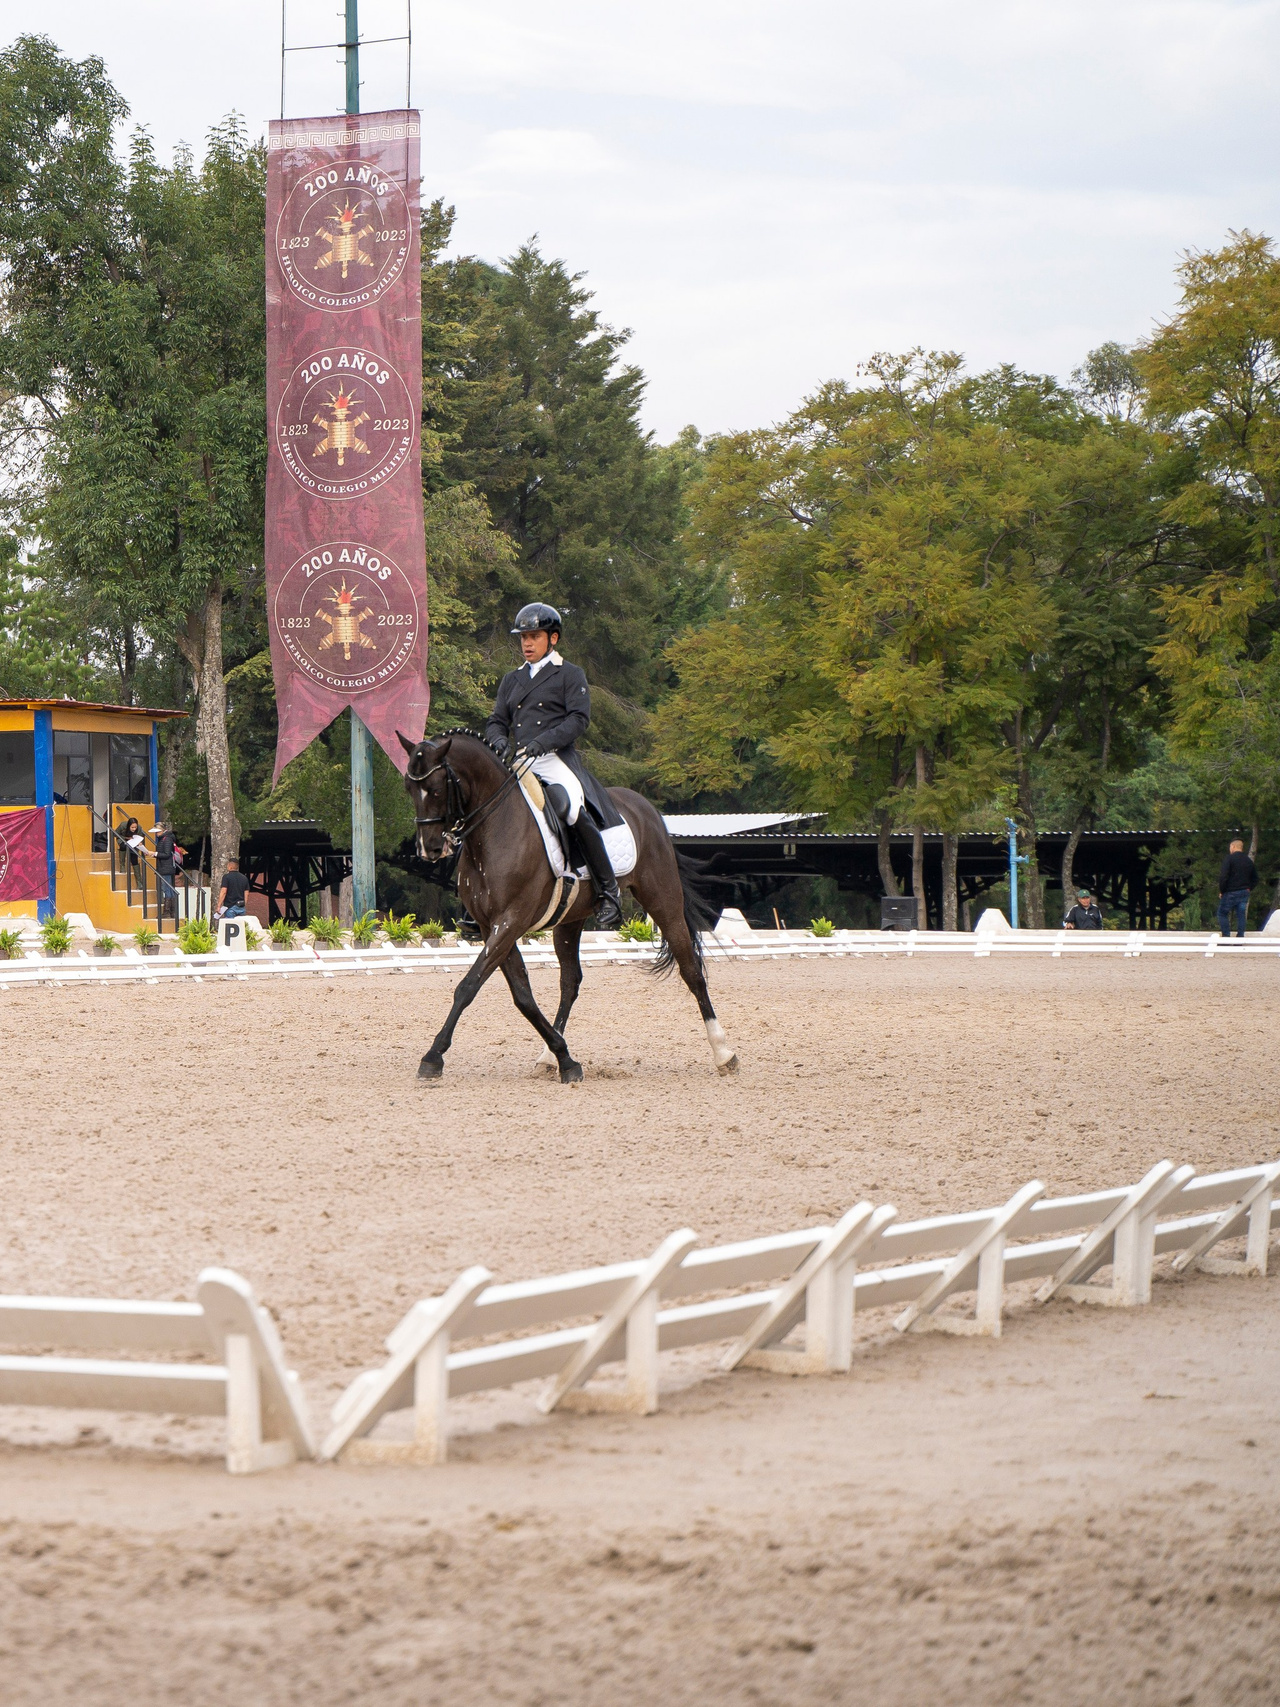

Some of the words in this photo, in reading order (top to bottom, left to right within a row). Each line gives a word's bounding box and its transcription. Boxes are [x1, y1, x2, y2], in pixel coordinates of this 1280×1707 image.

[304, 169, 339, 198] 200
[344, 165, 389, 196] AÑOS
[280, 236, 310, 250] 1823
[375, 229, 407, 243] 2023
[281, 255, 316, 300] HEROICO
[318, 292, 370, 307] COLEGIO
[373, 246, 407, 297] MILITAR
[300, 356, 333, 384] 200
[337, 351, 390, 385] AÑOS
[280, 424, 308, 437] 1823
[373, 418, 410, 431] 2023
[282, 442, 315, 488] HEROICO
[317, 481, 368, 494] COLEGIO
[371, 436, 411, 484] MILITAR
[301, 550, 333, 578] 200
[338, 547, 392, 581] AÑOS
[280, 617, 311, 629] 1823
[377, 614, 413, 626] 2023
[283, 633, 324, 680] HEROICO
[326, 675, 376, 688] COLEGIO
[378, 631, 415, 679] MILITAR
[225, 923, 240, 947] P
